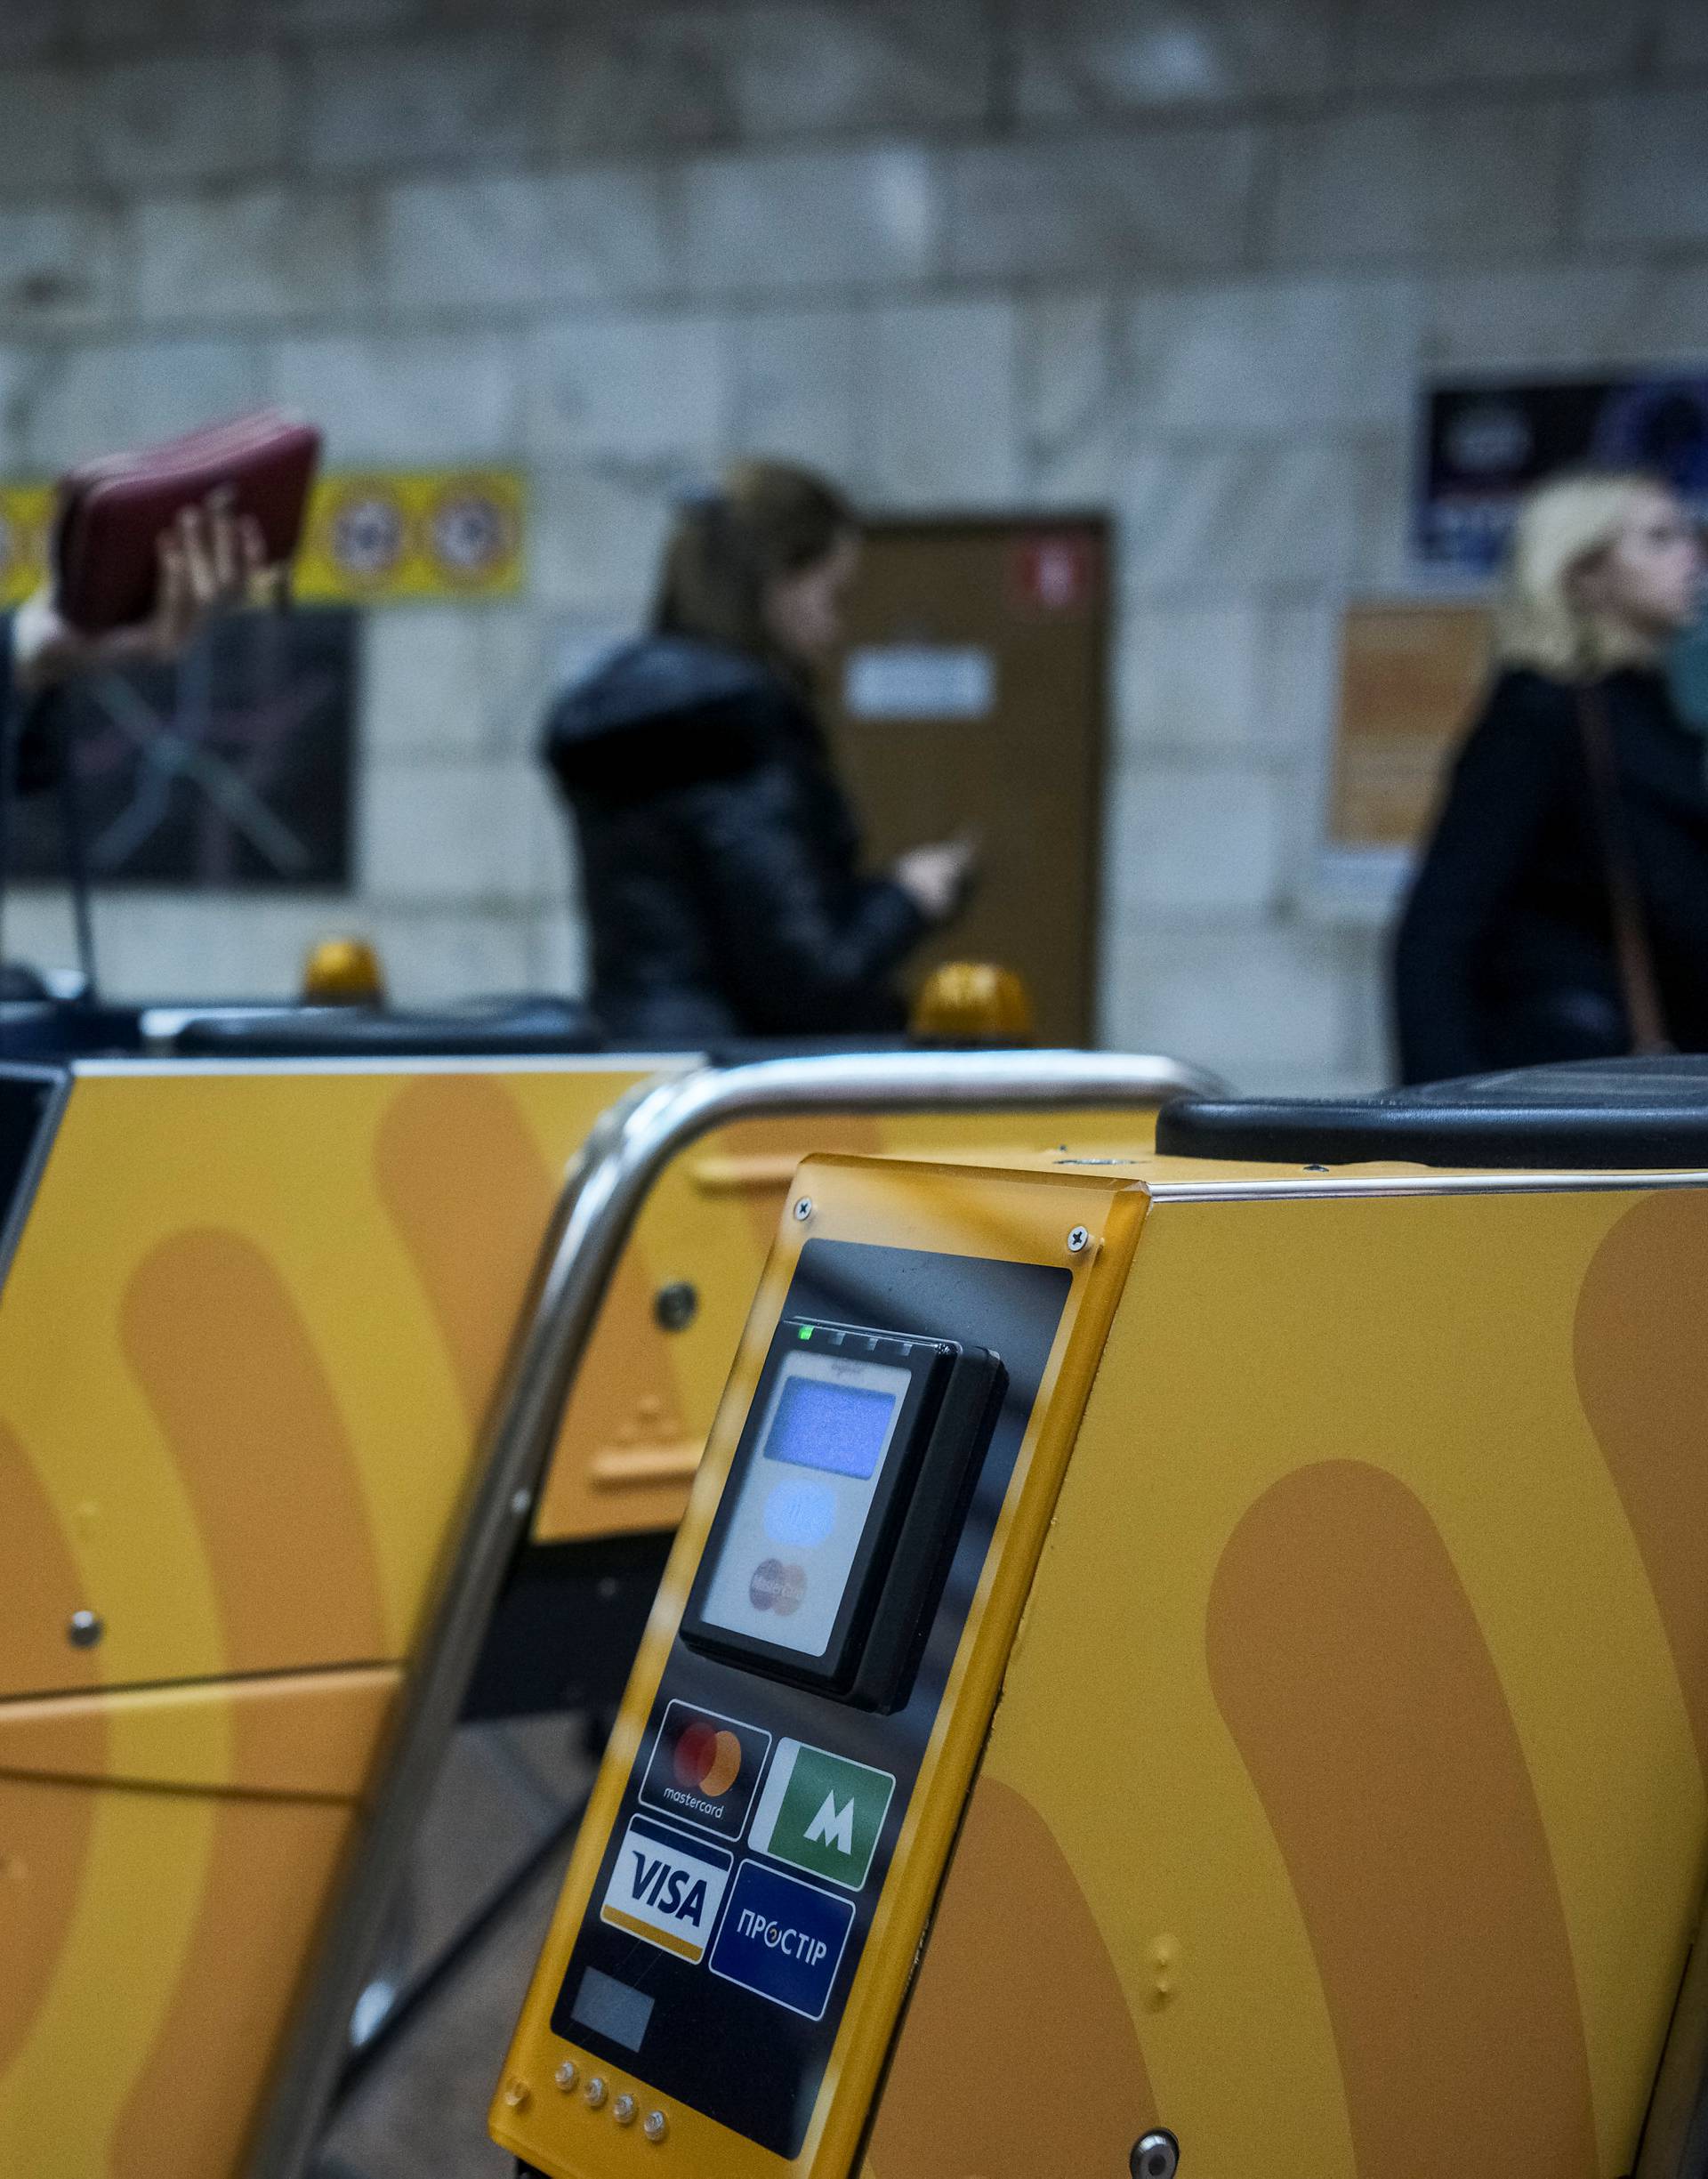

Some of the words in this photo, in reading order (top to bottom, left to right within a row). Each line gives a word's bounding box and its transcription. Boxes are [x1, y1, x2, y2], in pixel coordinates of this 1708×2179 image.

[664, 1788, 725, 1819] mastercard
[632, 1850, 707, 1928] VISA
[736, 1908, 828, 1966] ПРОСТІР
